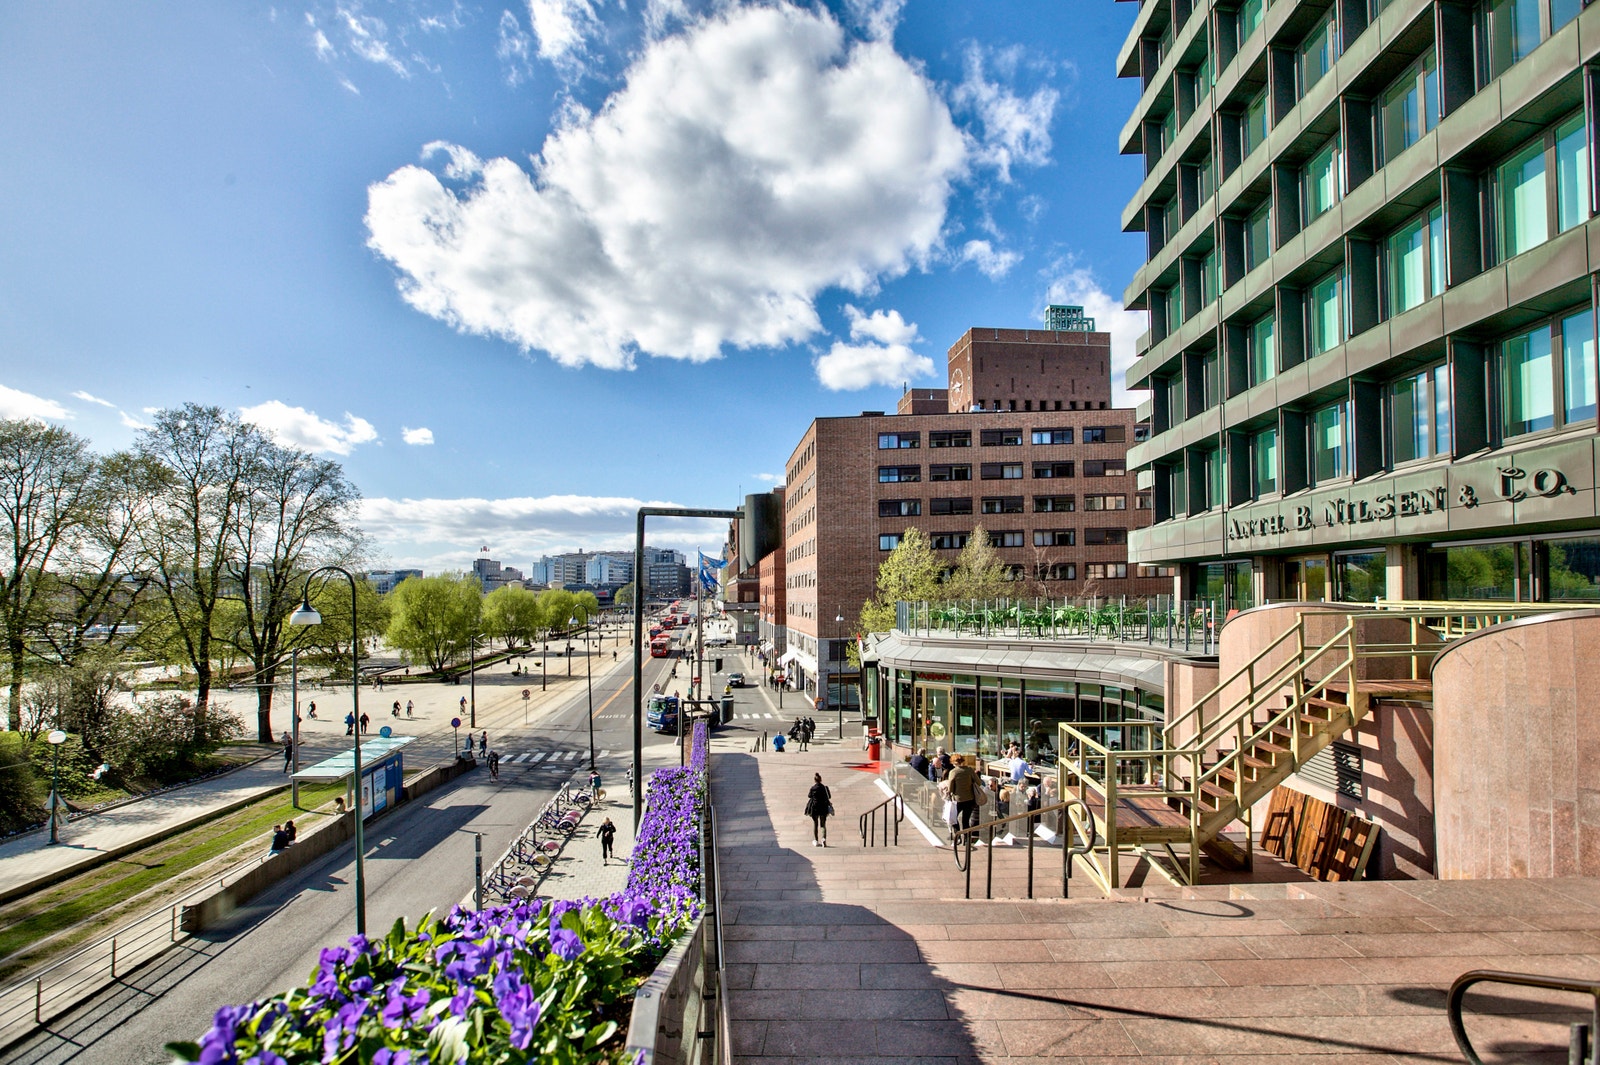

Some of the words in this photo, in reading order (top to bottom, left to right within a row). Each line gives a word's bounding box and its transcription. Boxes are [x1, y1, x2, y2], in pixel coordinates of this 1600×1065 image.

[1293, 505, 1317, 531] B.
[1324, 486, 1447, 528] NILSEN
[1458, 484, 1479, 509] &
[1494, 466, 1578, 503] CO.
